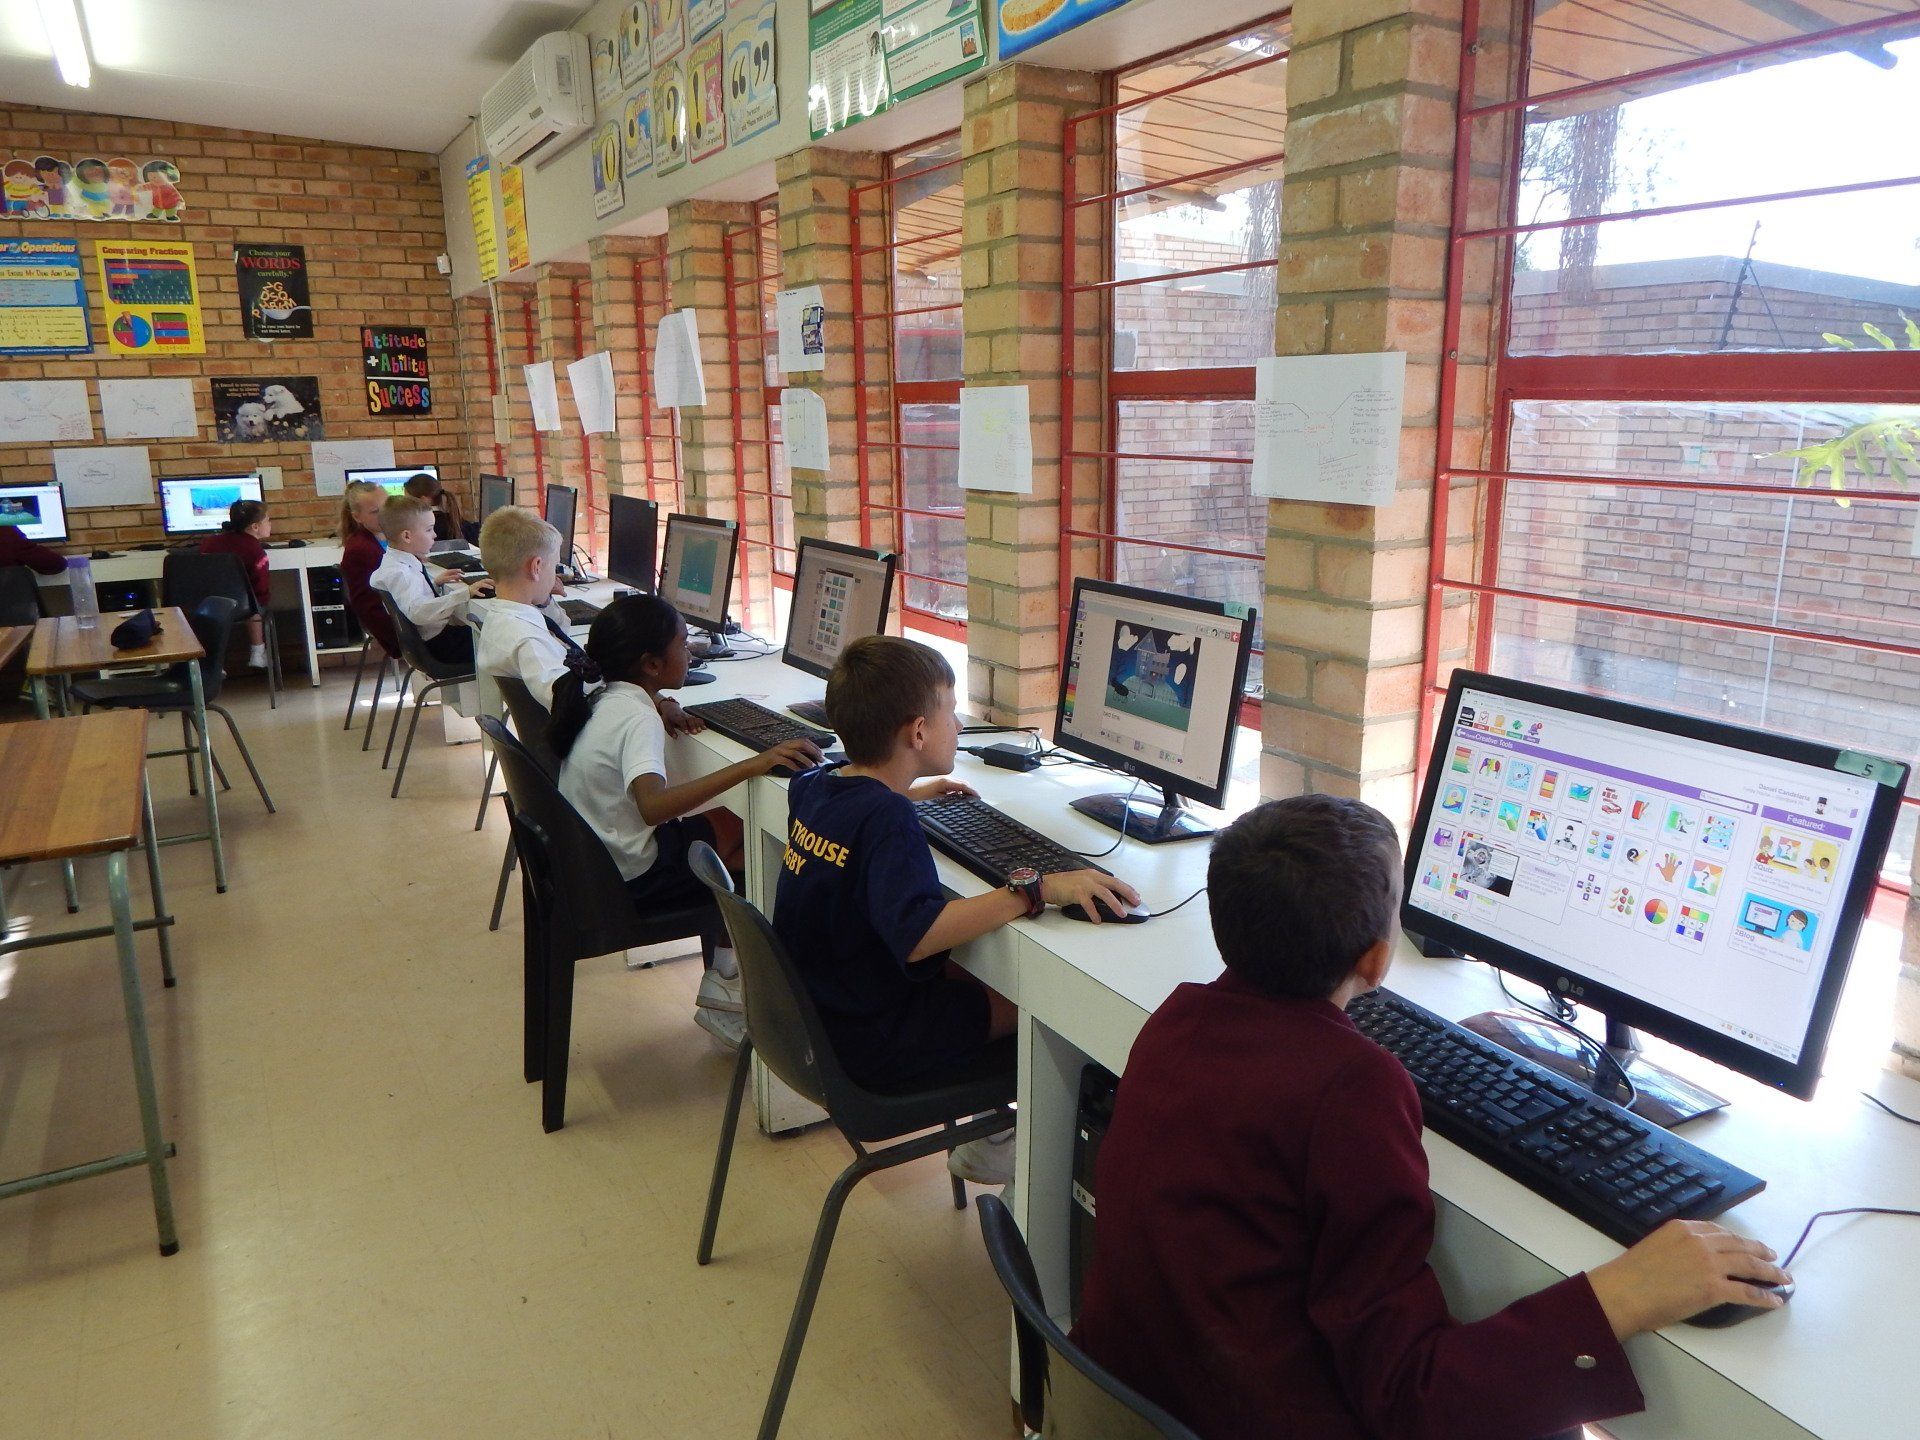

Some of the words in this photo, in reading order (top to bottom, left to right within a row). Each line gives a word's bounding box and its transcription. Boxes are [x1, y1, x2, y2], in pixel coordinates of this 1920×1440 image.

[149, 247, 189, 256] Fractions
[240, 256, 304, 270] WORDS
[364, 329, 426, 349] Attitude
[381, 353, 426, 376] Ability
[368, 381, 430, 413] Success
[1475, 733, 1498, 745] Creative
[1499, 739, 1514, 749] Tools
[1860, 763, 1874, 777] 5
[1787, 814, 1826, 832] Featured:
[1752, 863, 1774, 875] 2Quiz
[1734, 929, 1756, 942] 2Blog
[1570, 983, 1585, 997] LG
